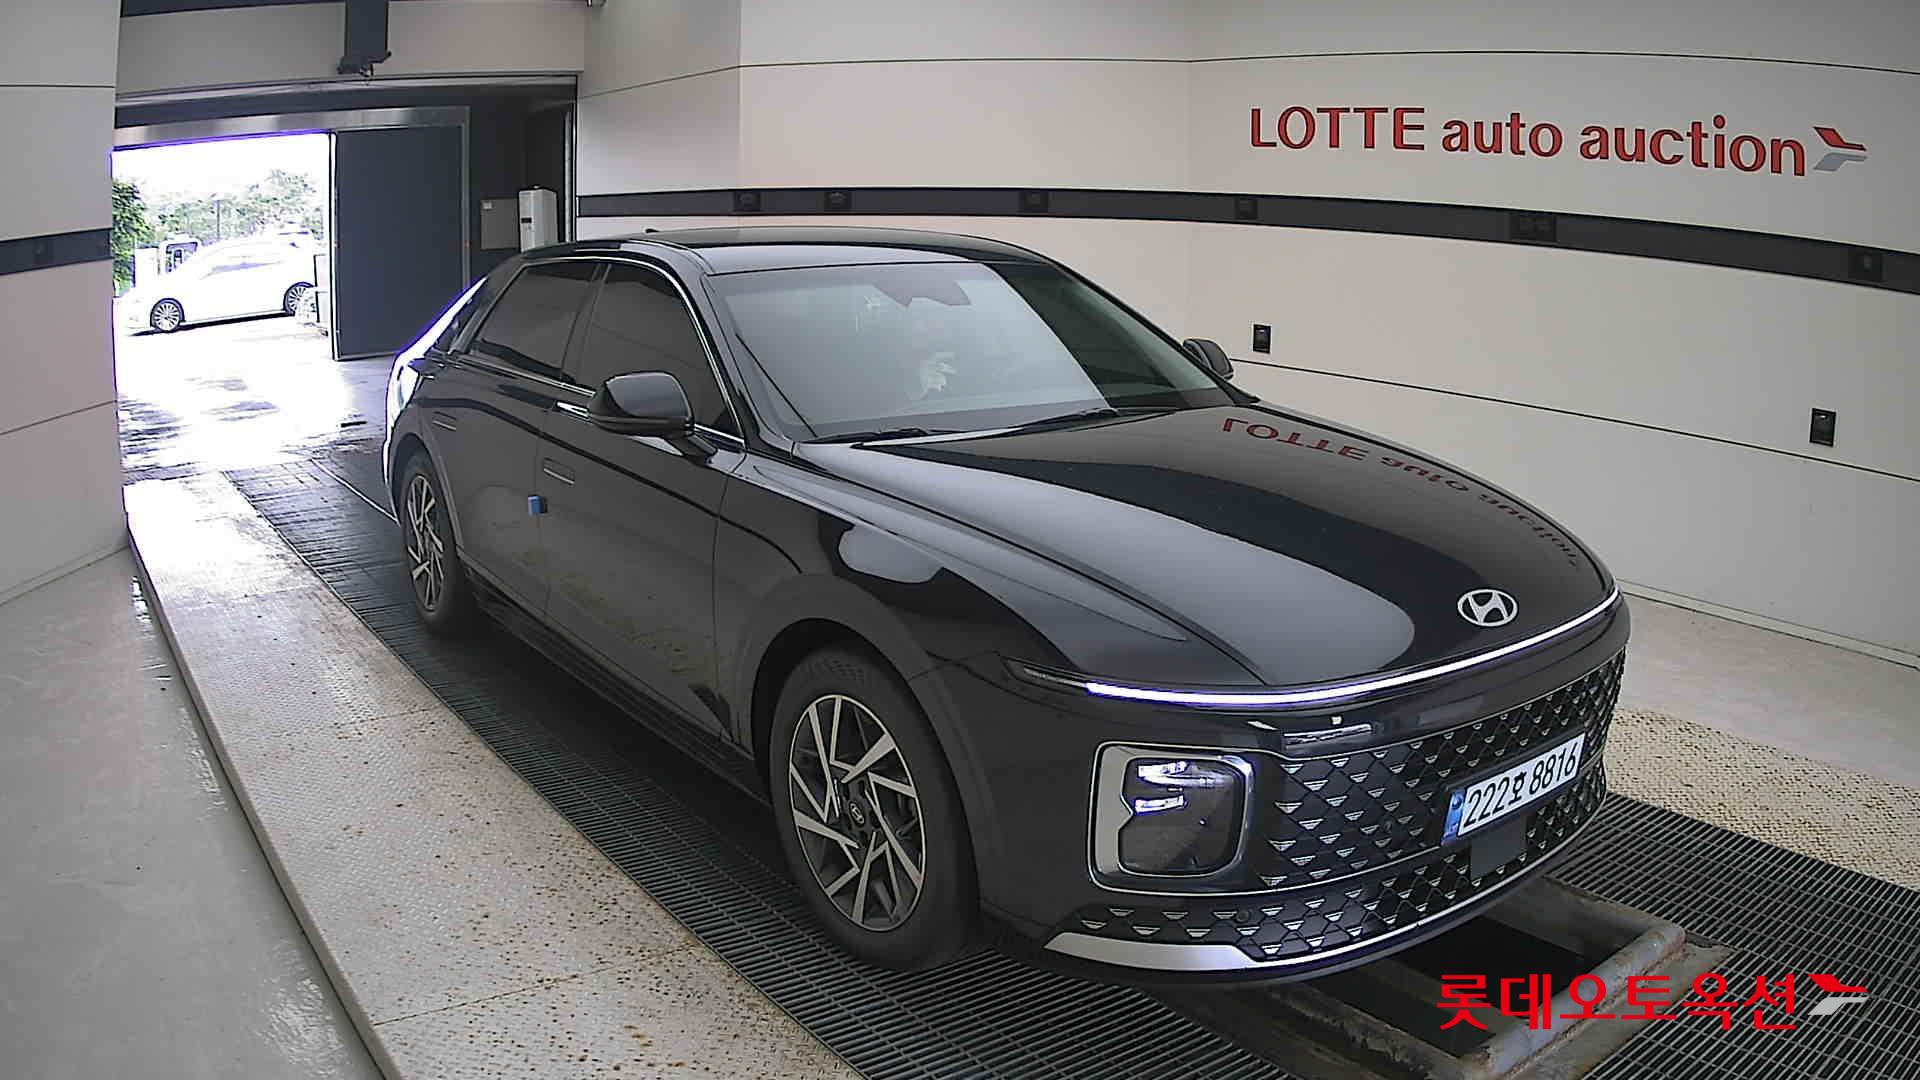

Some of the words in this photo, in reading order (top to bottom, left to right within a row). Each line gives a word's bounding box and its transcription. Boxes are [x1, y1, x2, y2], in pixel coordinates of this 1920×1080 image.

[1250, 106, 1425, 151] LOTTE
[1441, 112, 1562, 158] auto
[1579, 115, 1807, 176] auction
[1528, 741, 1578, 795] 8816
